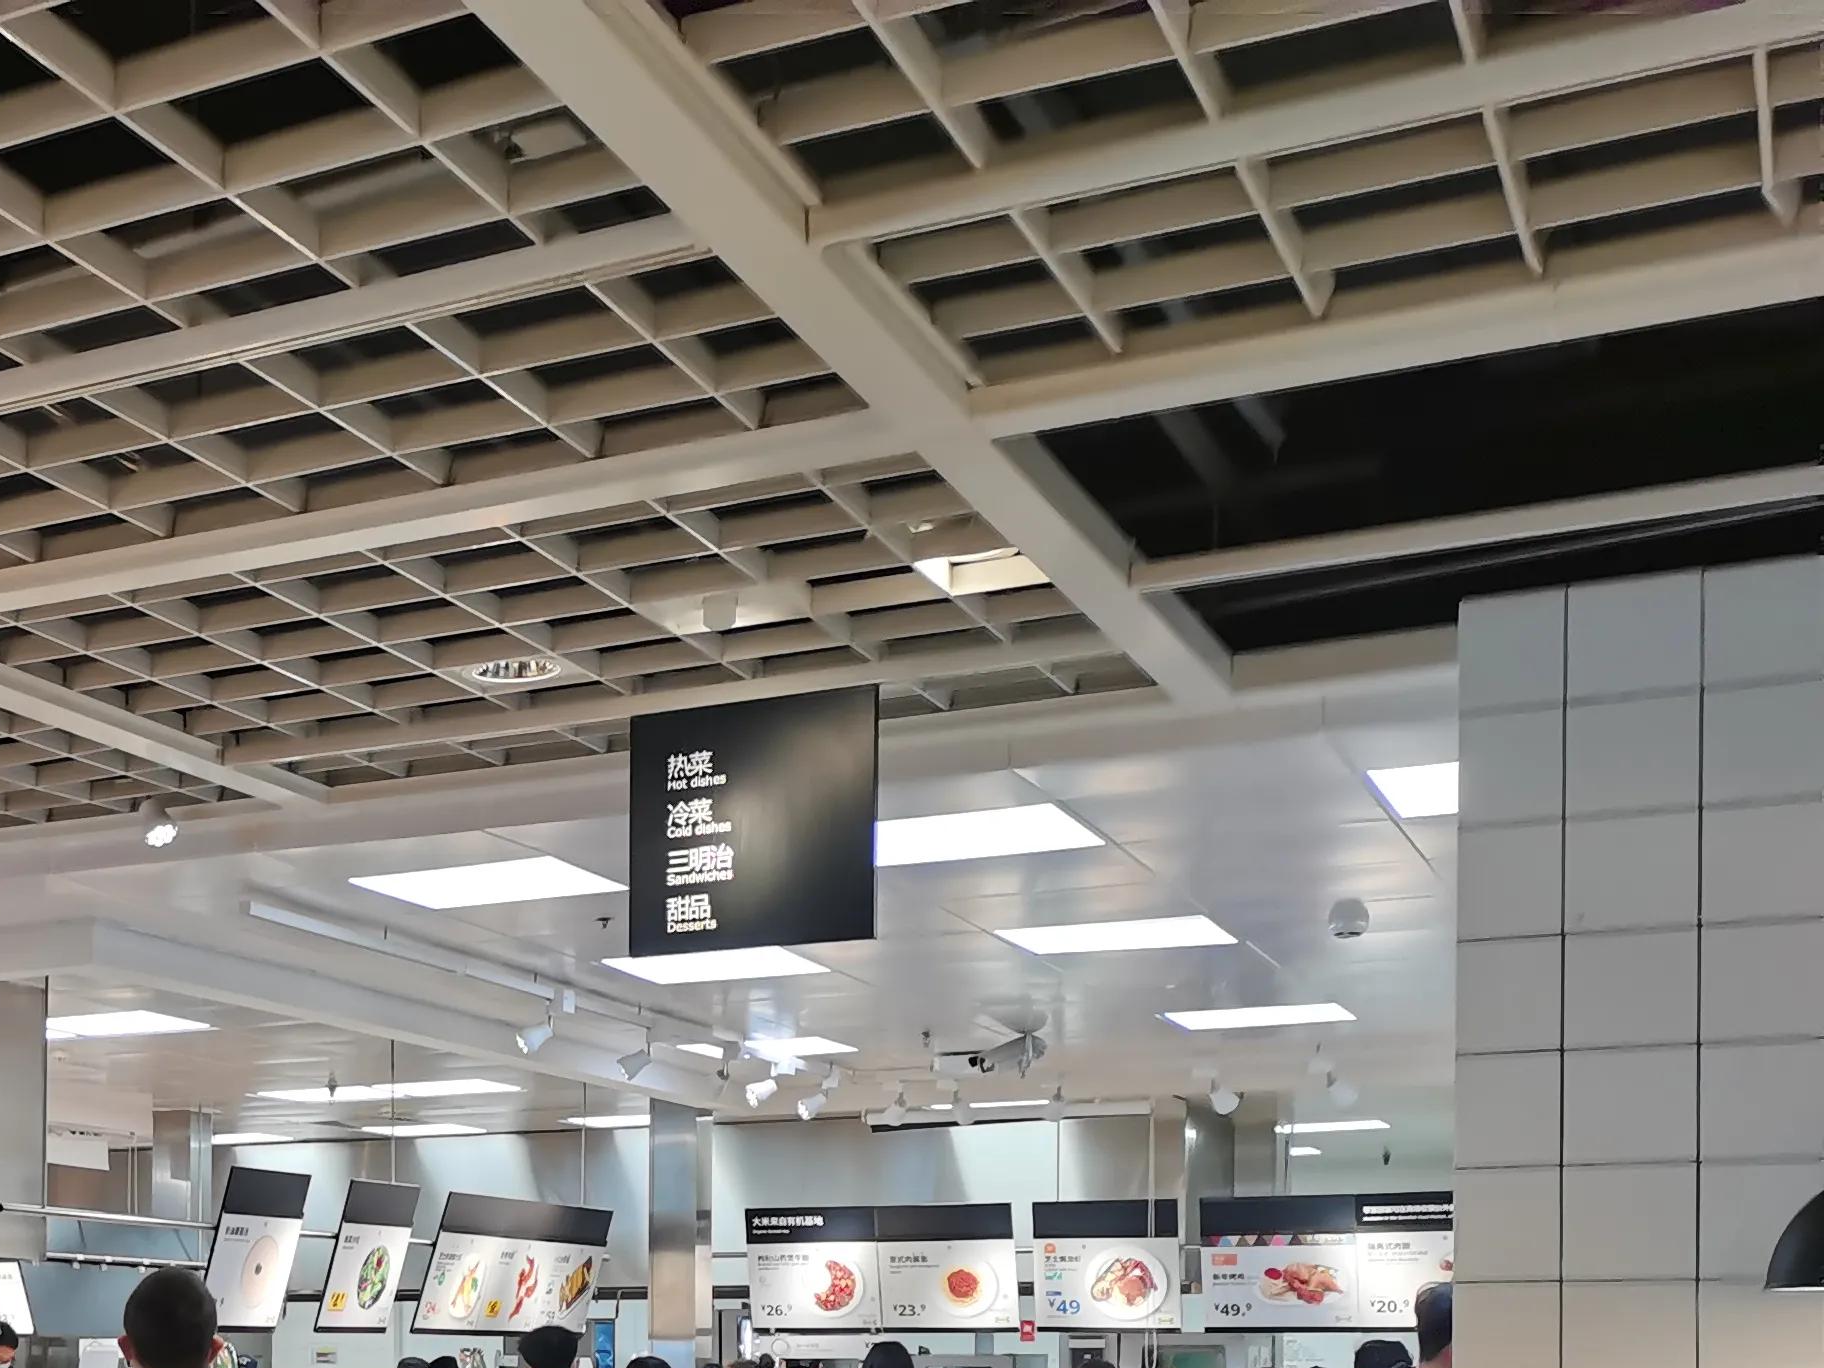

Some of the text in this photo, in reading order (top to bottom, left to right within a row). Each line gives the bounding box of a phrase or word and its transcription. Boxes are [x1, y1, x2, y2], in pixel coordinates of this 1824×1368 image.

[667, 751, 714, 779] 热菜
[667, 774, 727, 791] Hot dishes
[667, 798, 713, 826] 冷菜
[666, 820, 732, 839] Cold dishes
[666, 843, 734, 873] 三明治
[666, 868, 734, 886] Sandwiches
[666, 893, 711, 920] 甜品
[666, 918, 717, 933] Desserts
[893, 1303, 926, 1316] ¥23.9
[1048, 1298, 1080, 1315] ¥49
[1214, 1302, 1252, 1316] ¥49.9
